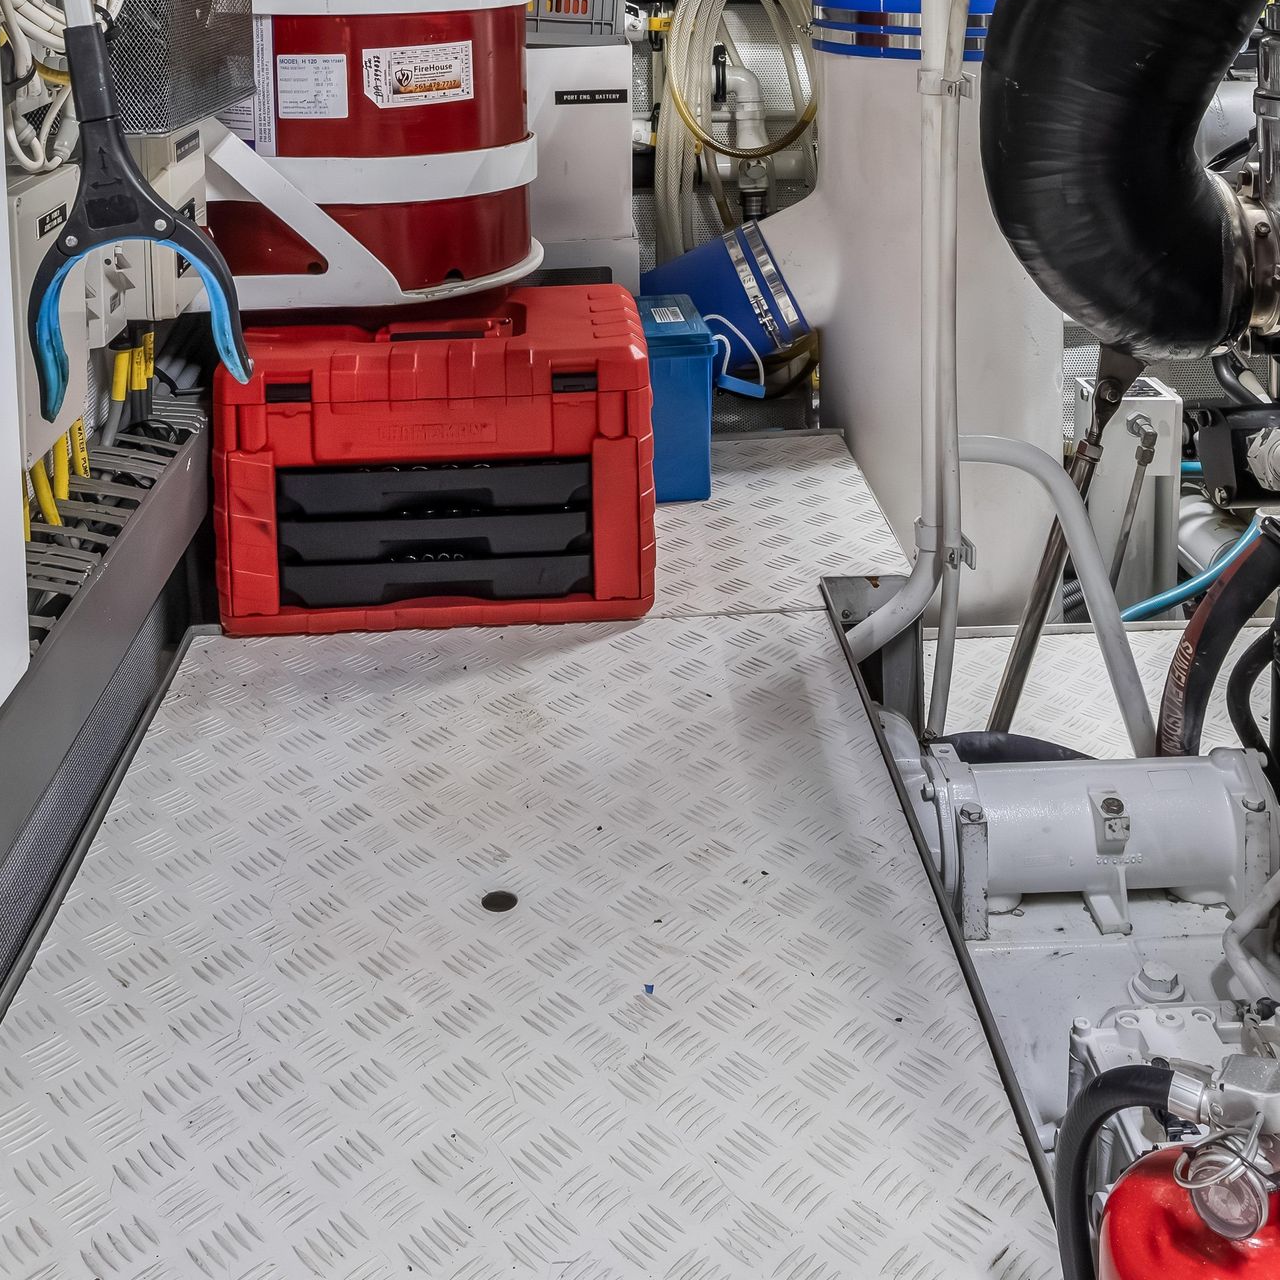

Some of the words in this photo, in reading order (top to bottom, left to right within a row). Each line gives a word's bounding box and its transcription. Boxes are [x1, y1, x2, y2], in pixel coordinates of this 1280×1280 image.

[413, 63, 453, 73] FireHouse
[77, 425, 85, 453] WATER
[81, 457, 89, 477] PUMP
